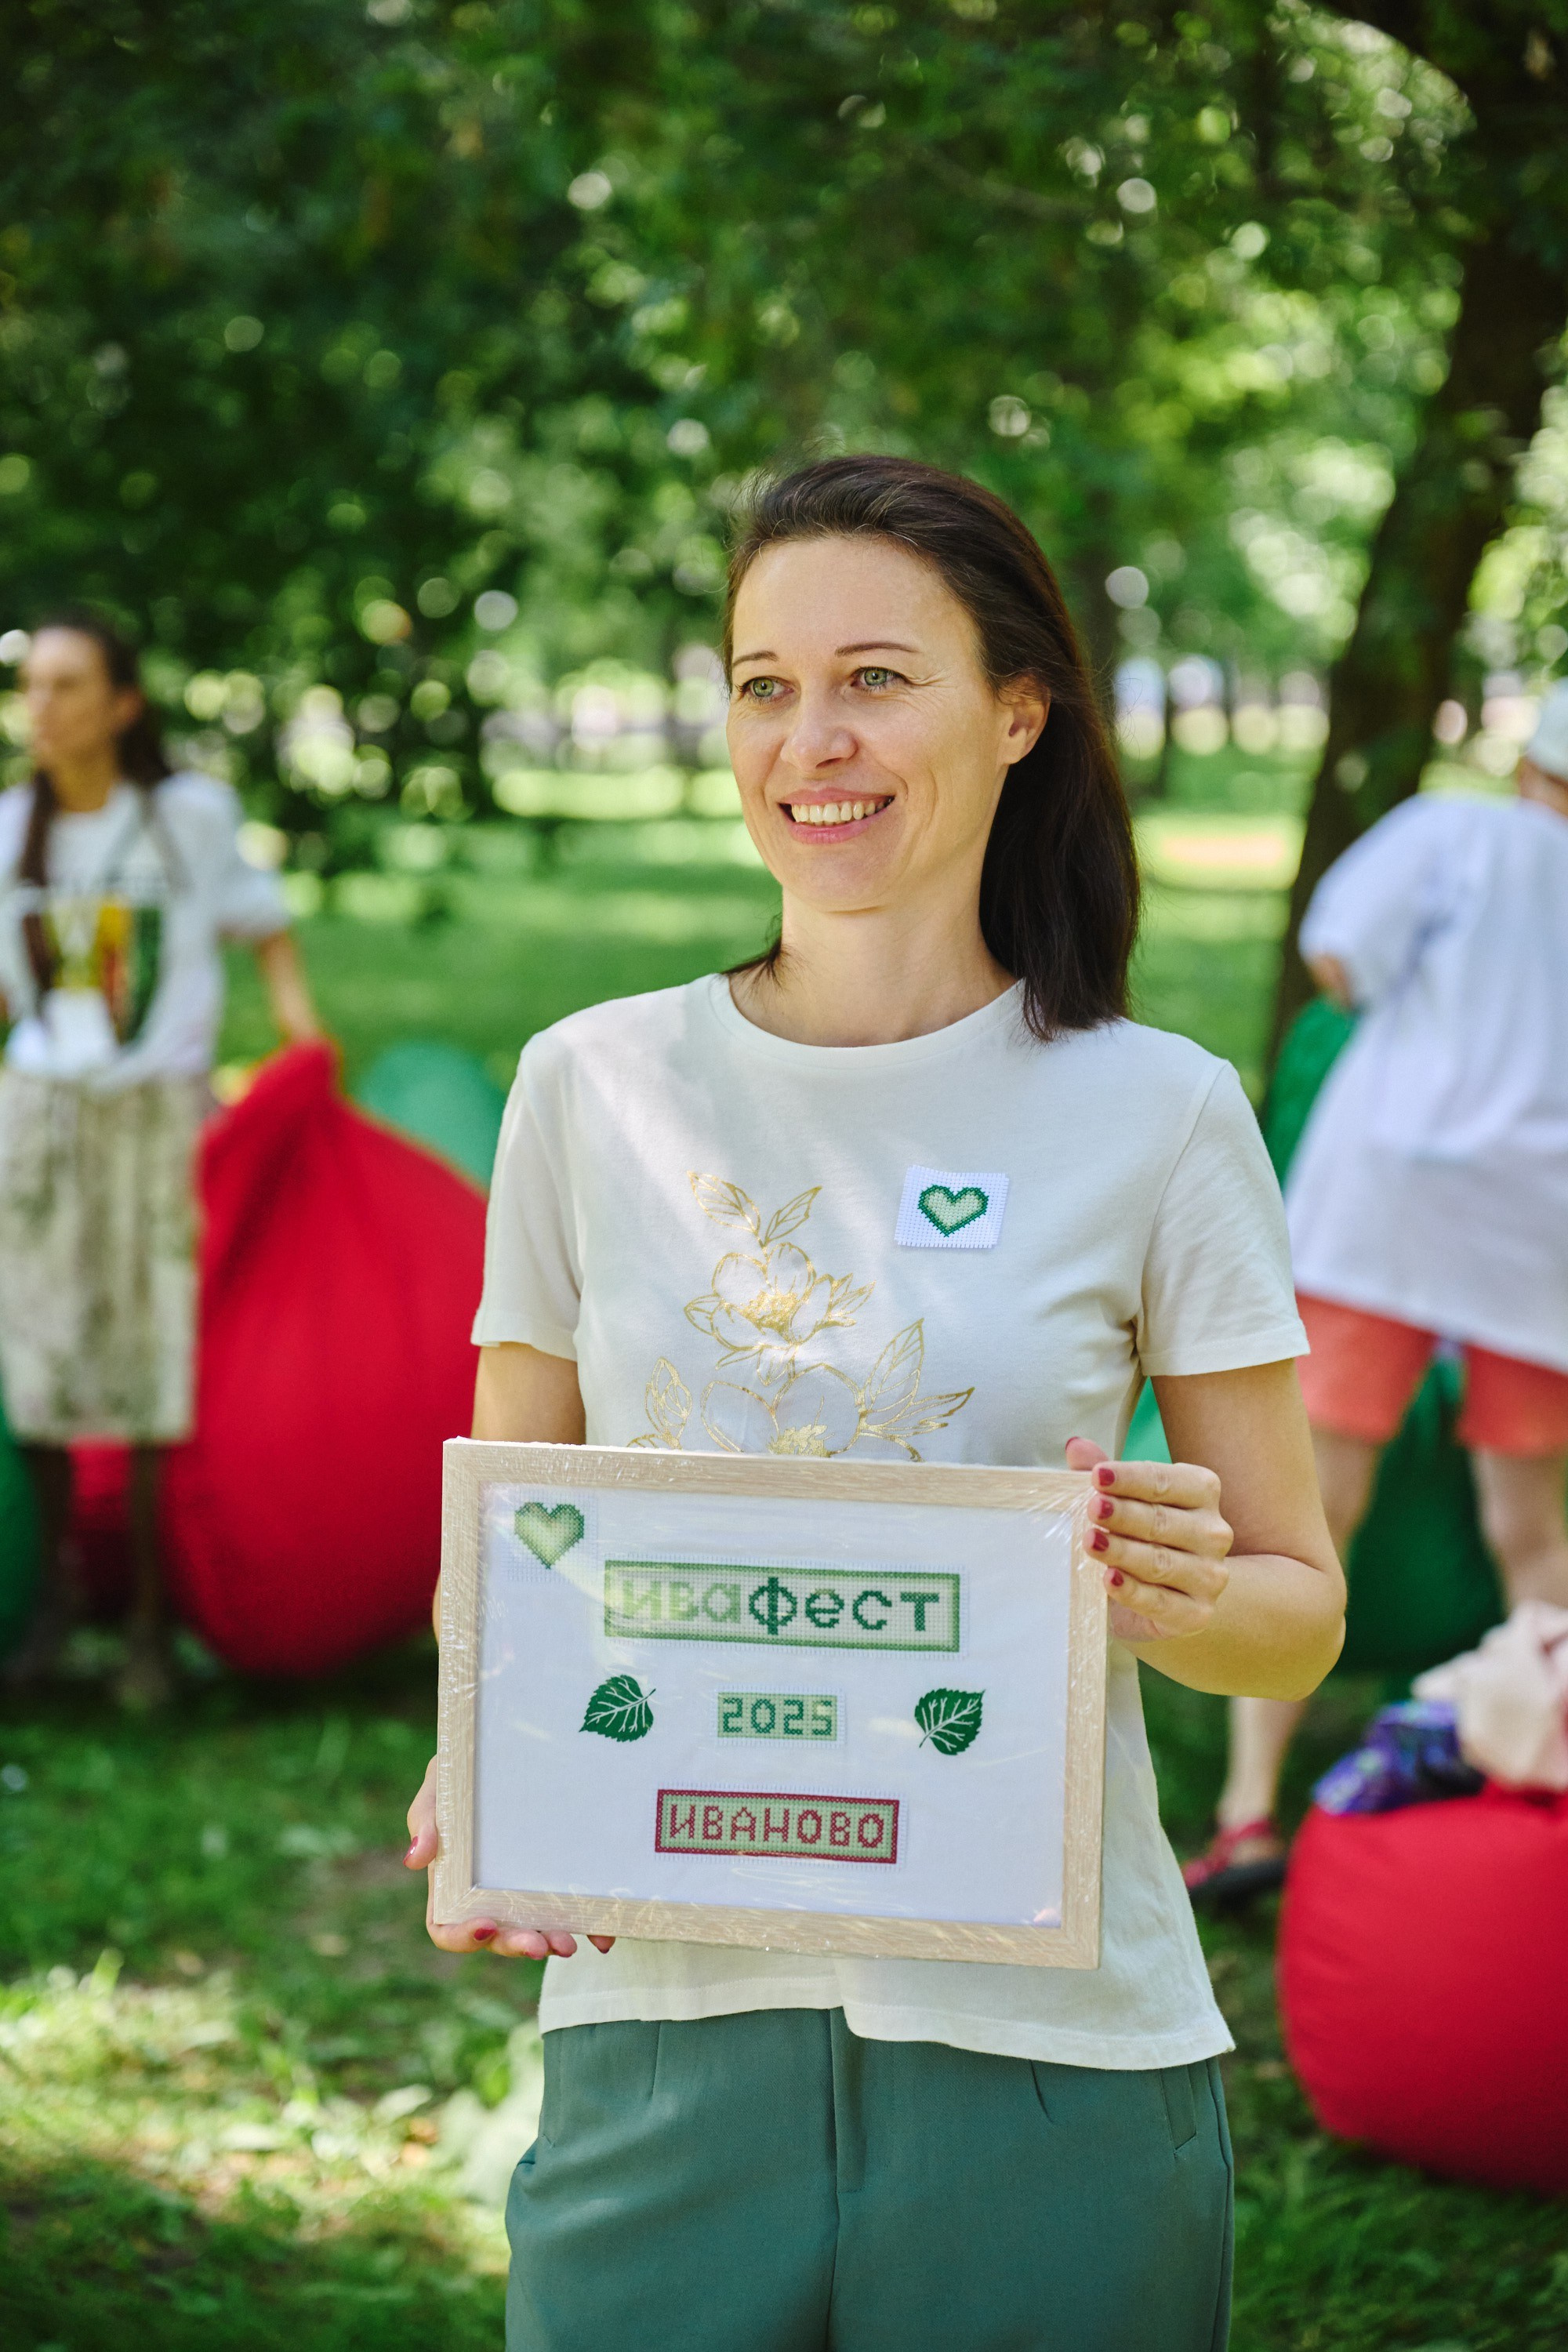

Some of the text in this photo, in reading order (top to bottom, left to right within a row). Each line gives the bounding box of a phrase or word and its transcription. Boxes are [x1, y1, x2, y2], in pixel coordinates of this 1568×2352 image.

[622, 1577, 939, 1635] ивафест
[722, 1697, 833, 1736] 2025
[669, 1804, 884, 1849] ИВАНОВО
